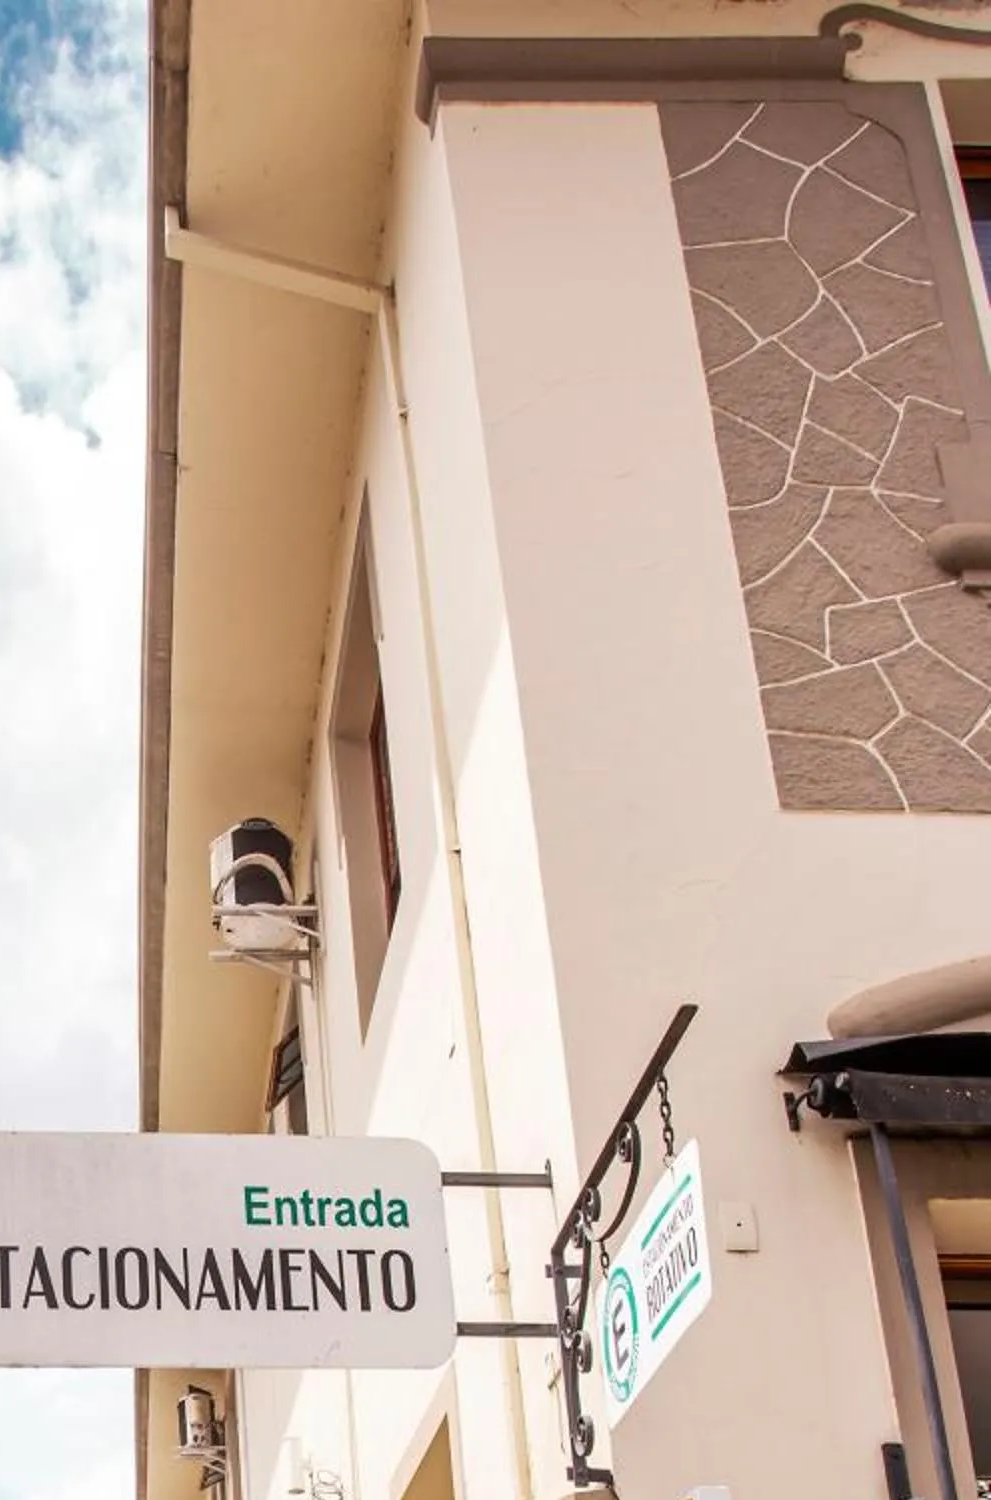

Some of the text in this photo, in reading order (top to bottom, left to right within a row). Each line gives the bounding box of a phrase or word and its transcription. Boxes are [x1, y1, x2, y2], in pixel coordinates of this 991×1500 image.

[243, 1185, 410, 1228] Entrada
[646, 1226, 698, 1324] ROTATIVO
[612, 1298, 629, 1370] E
